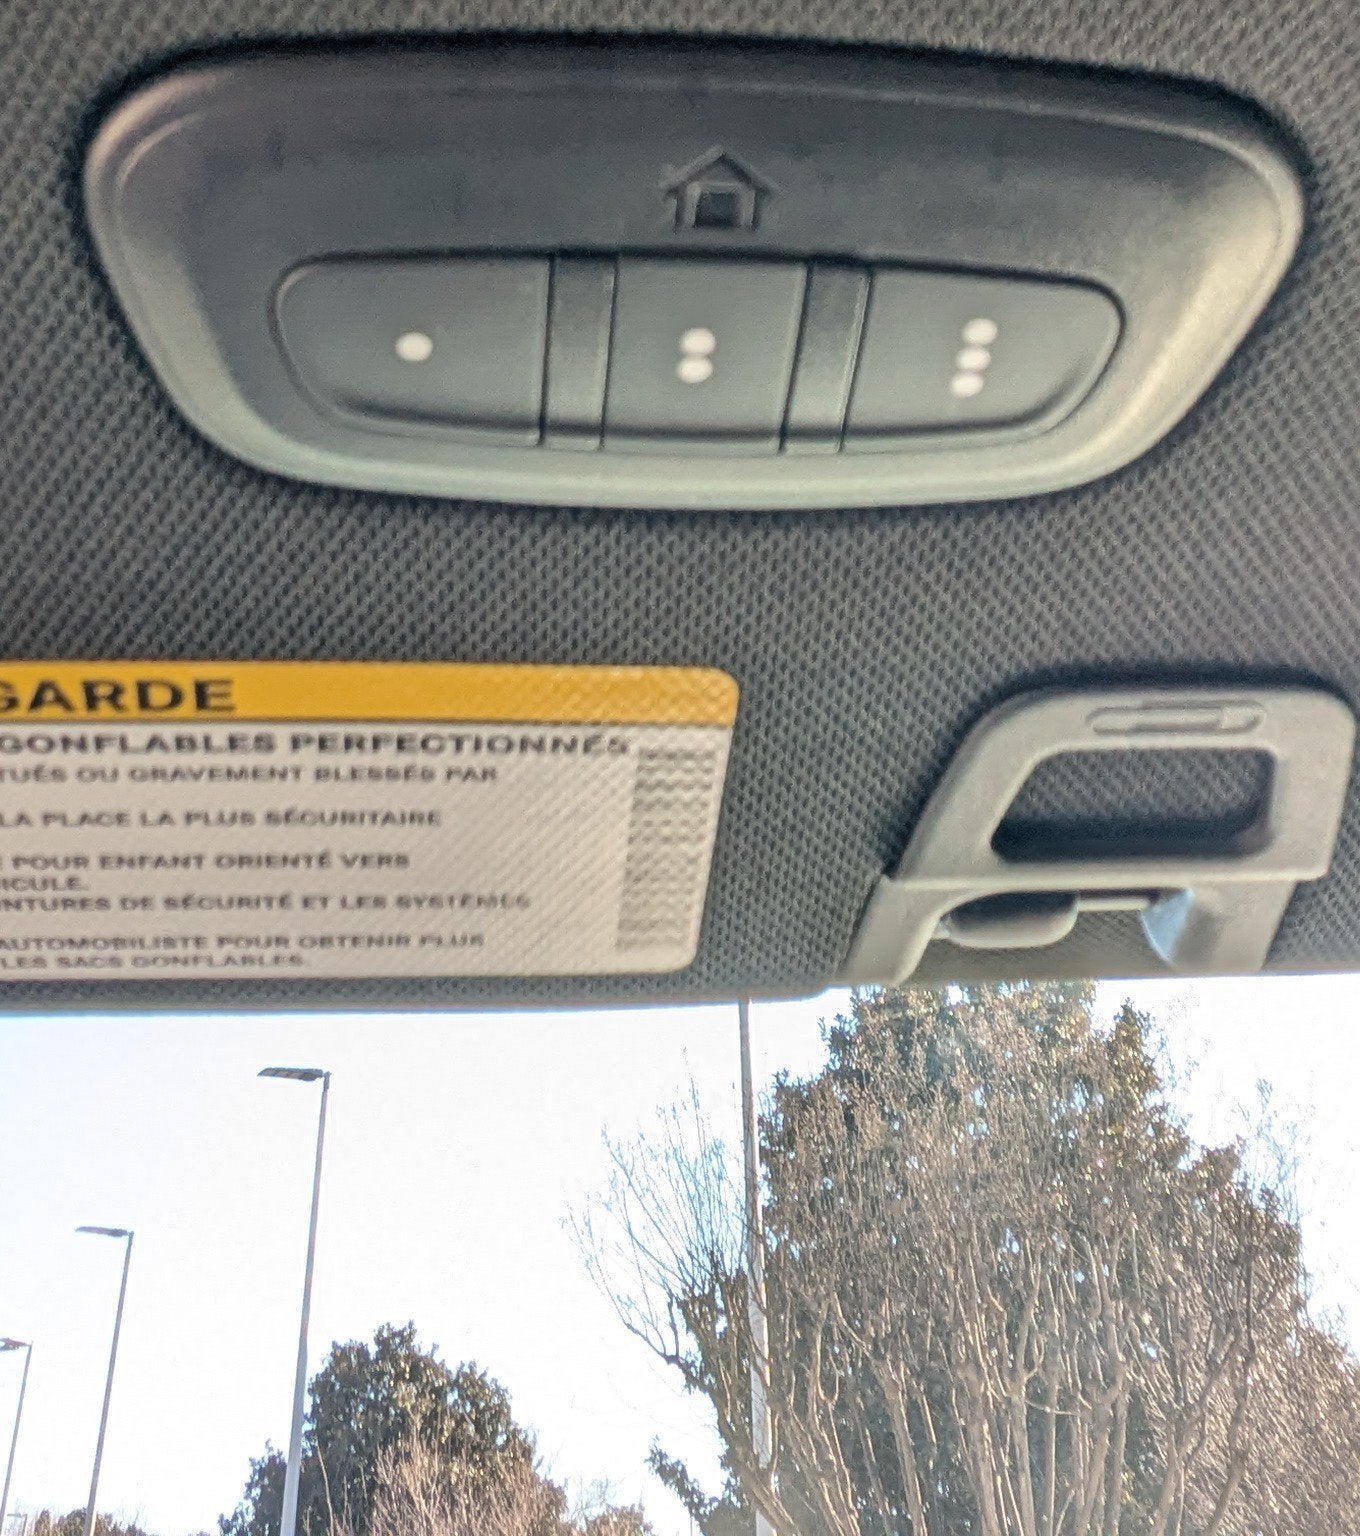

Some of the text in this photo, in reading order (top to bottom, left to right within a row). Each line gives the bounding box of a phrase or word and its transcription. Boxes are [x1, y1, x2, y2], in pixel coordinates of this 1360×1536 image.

[291, 733, 630, 755] PERFECTIONNÉS
[77, 769, 118, 782] OU
[130, 767, 302, 782] GRAVEMENT
[446, 769, 497, 782] PAR
[45, 812, 130, 827] PLACE
[140, 812, 175, 827] LA
[13, 856, 90, 871] POUR
[99, 855, 205, 870] ENFANT
[215, 852, 332, 869] ORIENTÉ
[341, 855, 409, 868] VERS
[121, 897, 154, 910] DE
[164, 893, 292, 911] SÉCURITÉ
[302, 896, 331, 910] ET
[340, 896, 387, 909] LES
[217, 936, 290, 950] POUR
[1, 957, 47, 970] LES
[57, 955, 123, 969] SACS
